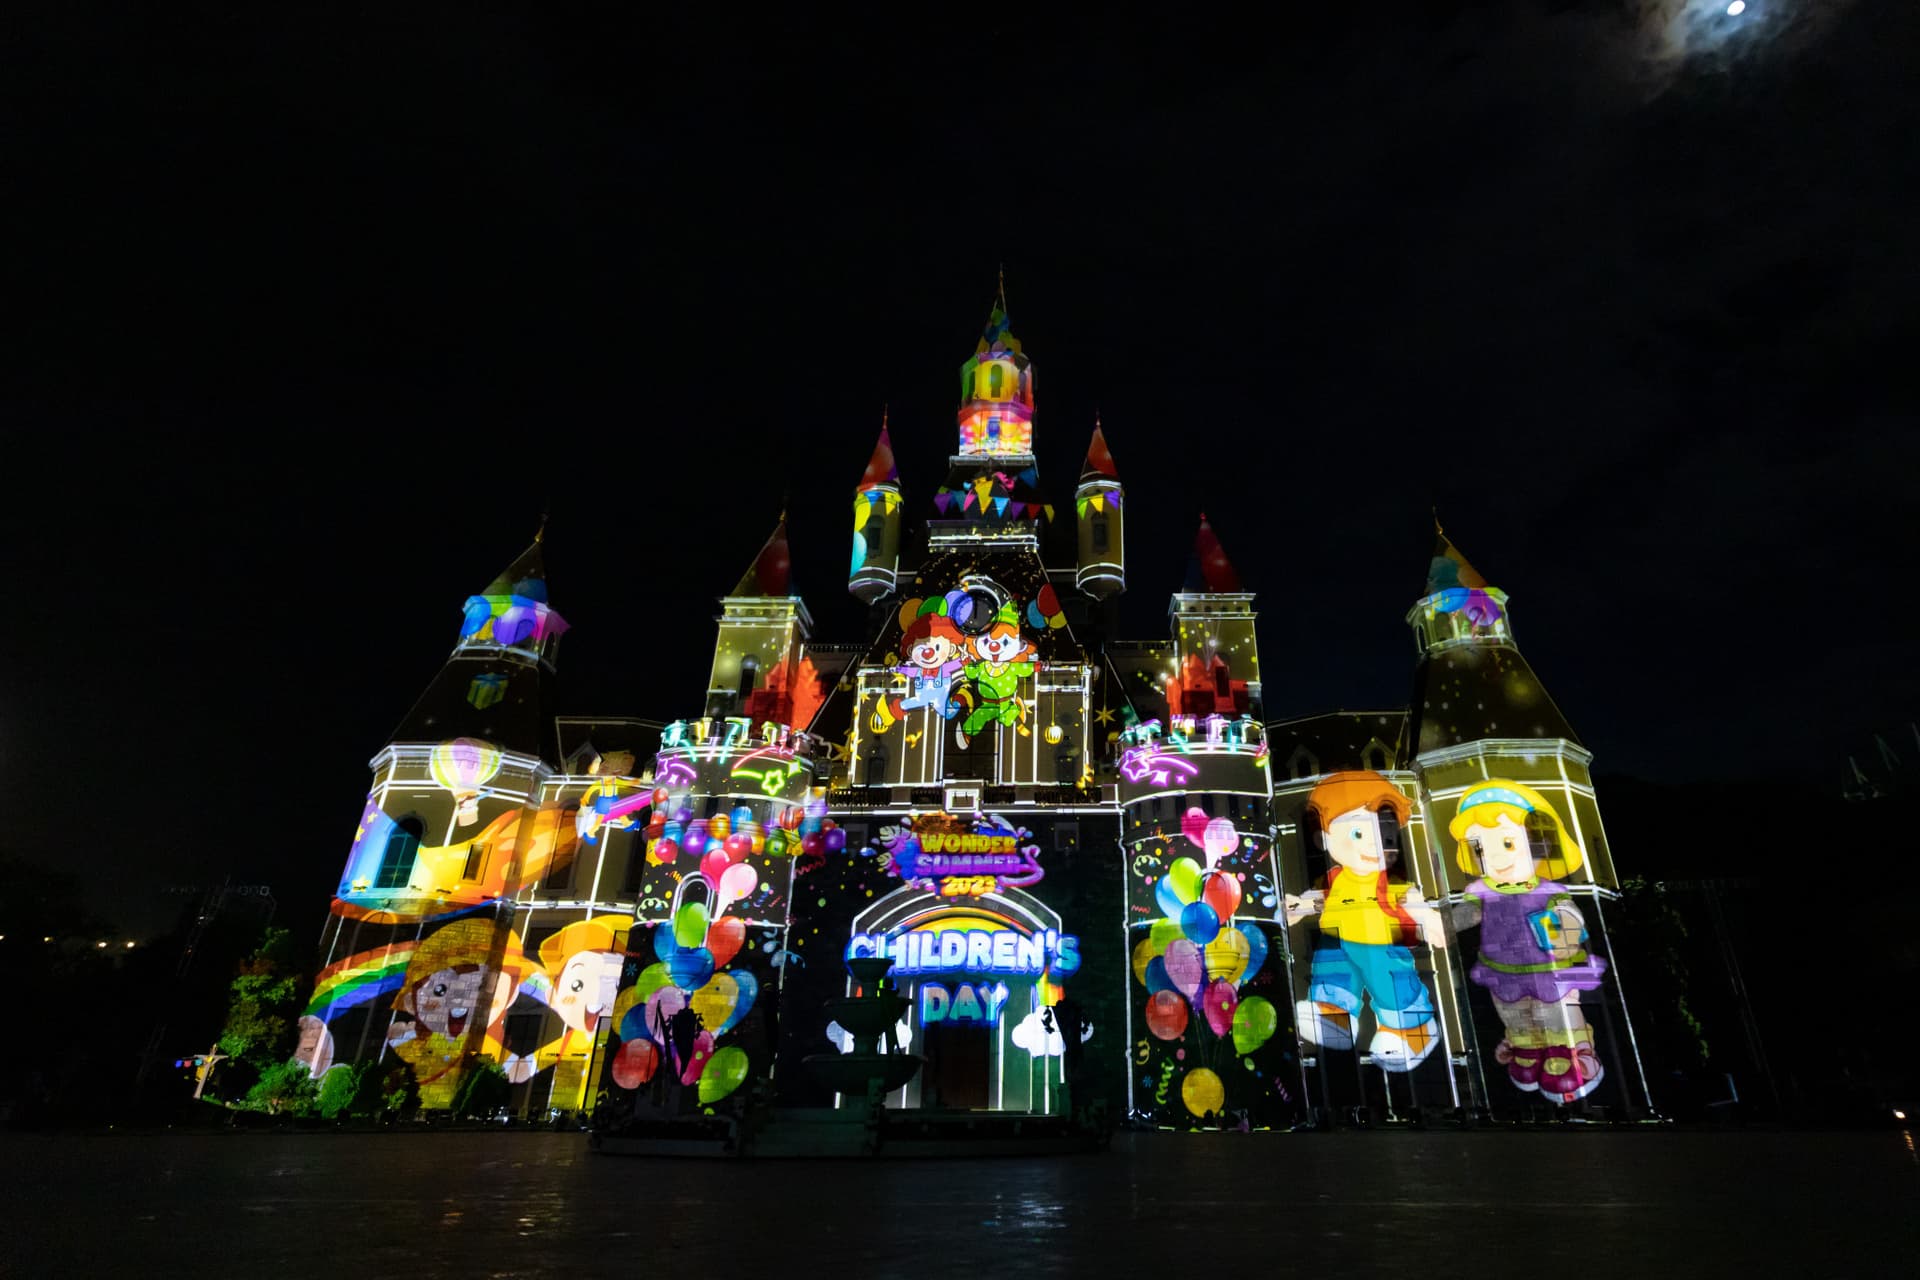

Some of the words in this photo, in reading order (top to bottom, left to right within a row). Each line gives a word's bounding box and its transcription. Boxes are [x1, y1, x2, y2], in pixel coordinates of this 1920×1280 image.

[920, 833, 1017, 853] WONDER
[915, 855, 1021, 875] SUMMER
[941, 876, 996, 896] 2023
[846, 929, 1078, 971] CHILDREN'S
[922, 982, 1008, 1023] DAY
